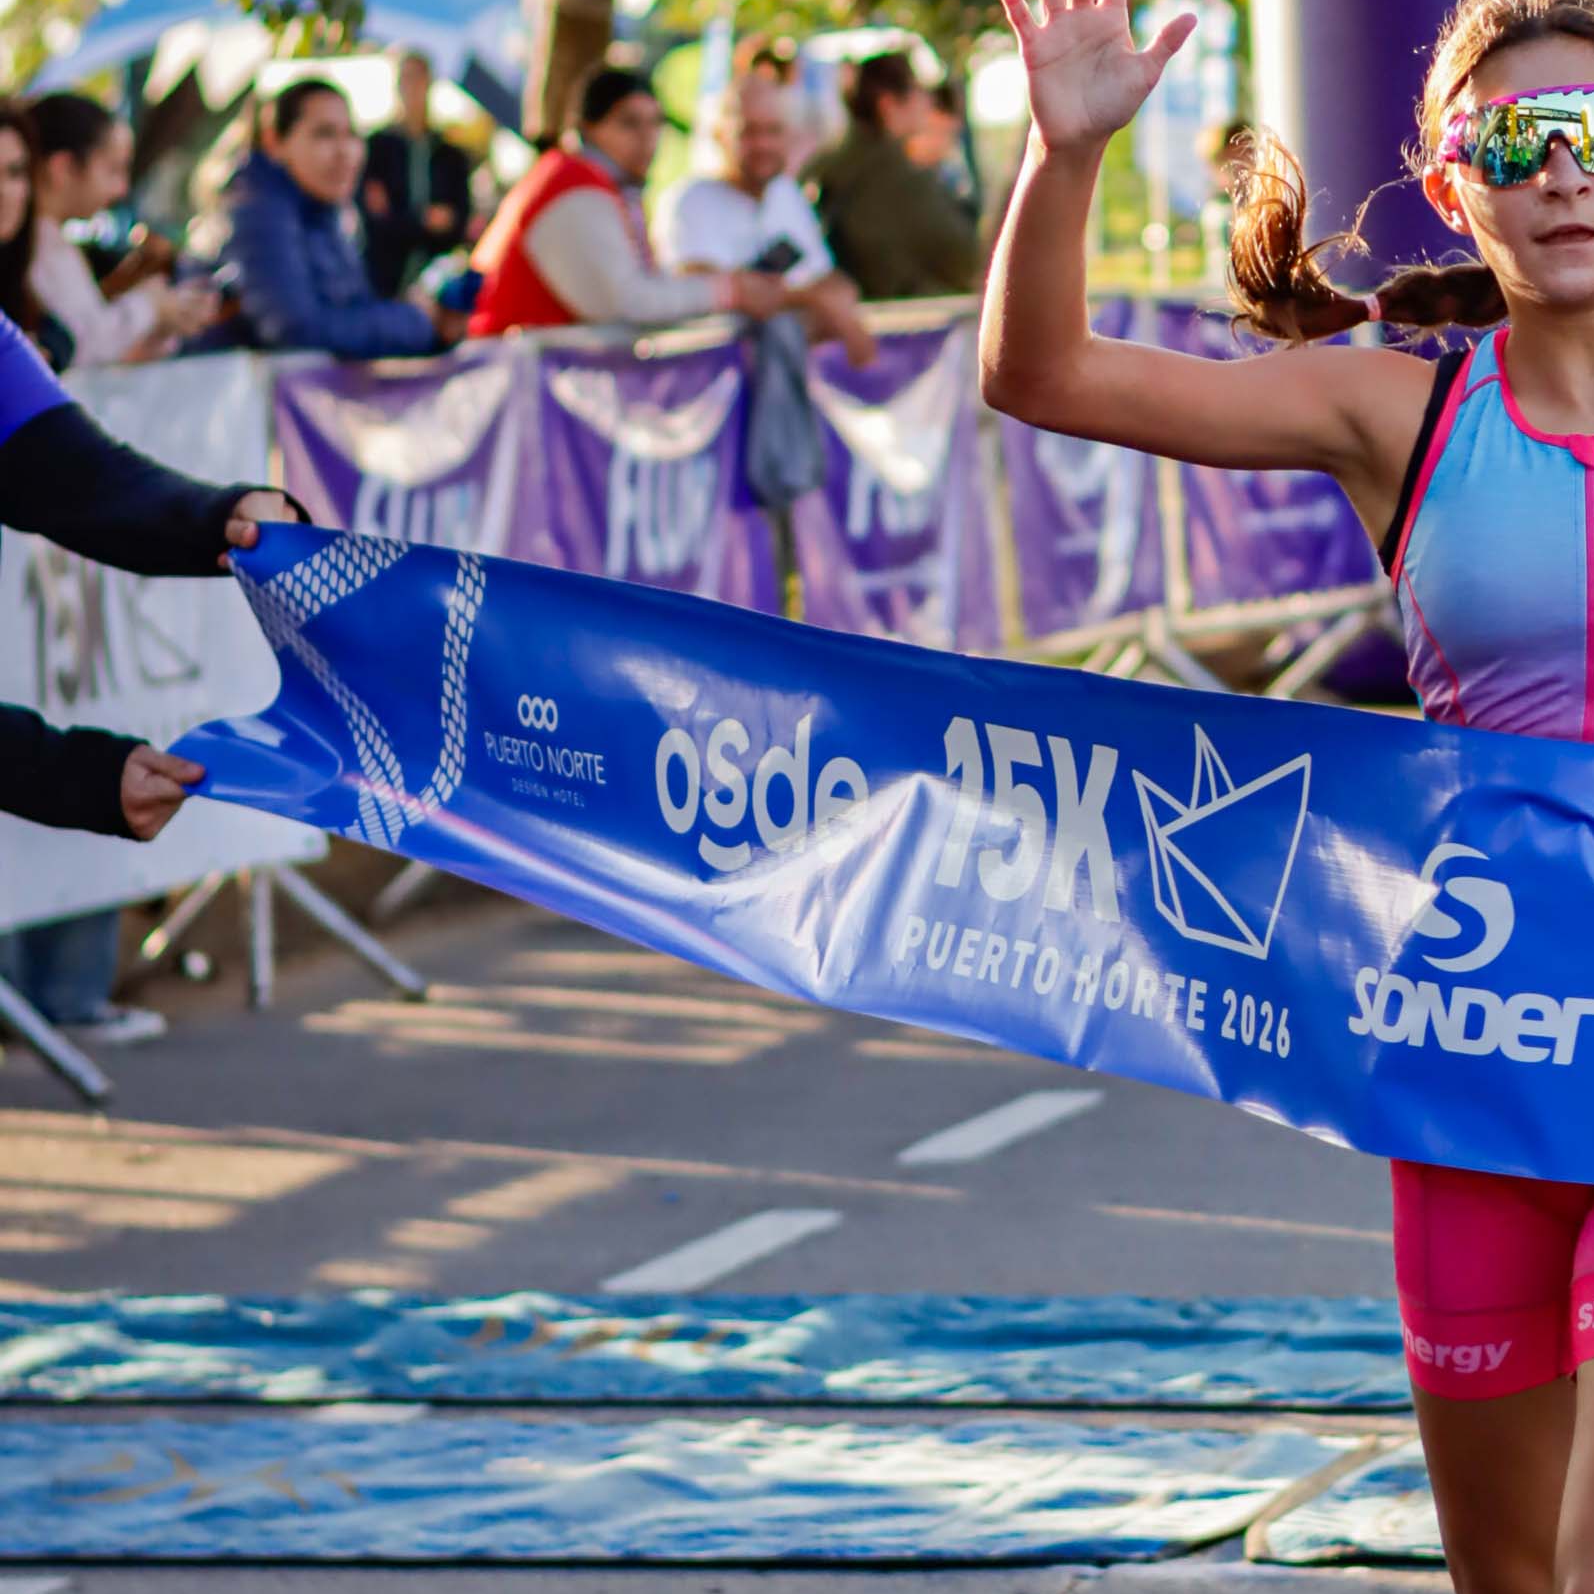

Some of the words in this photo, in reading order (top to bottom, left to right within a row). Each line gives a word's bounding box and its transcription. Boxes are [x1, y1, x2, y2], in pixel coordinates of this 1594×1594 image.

[484, 730, 545, 773] PUERTO
[546, 744, 608, 785] NORTE
[655, 713, 871, 867] osde
[935, 715, 1121, 924] 15K
[896, 916, 1061, 995] PUERTO
[1072, 954, 1208, 1032] NORTE
[1220, 988, 1291, 1059] 2026
